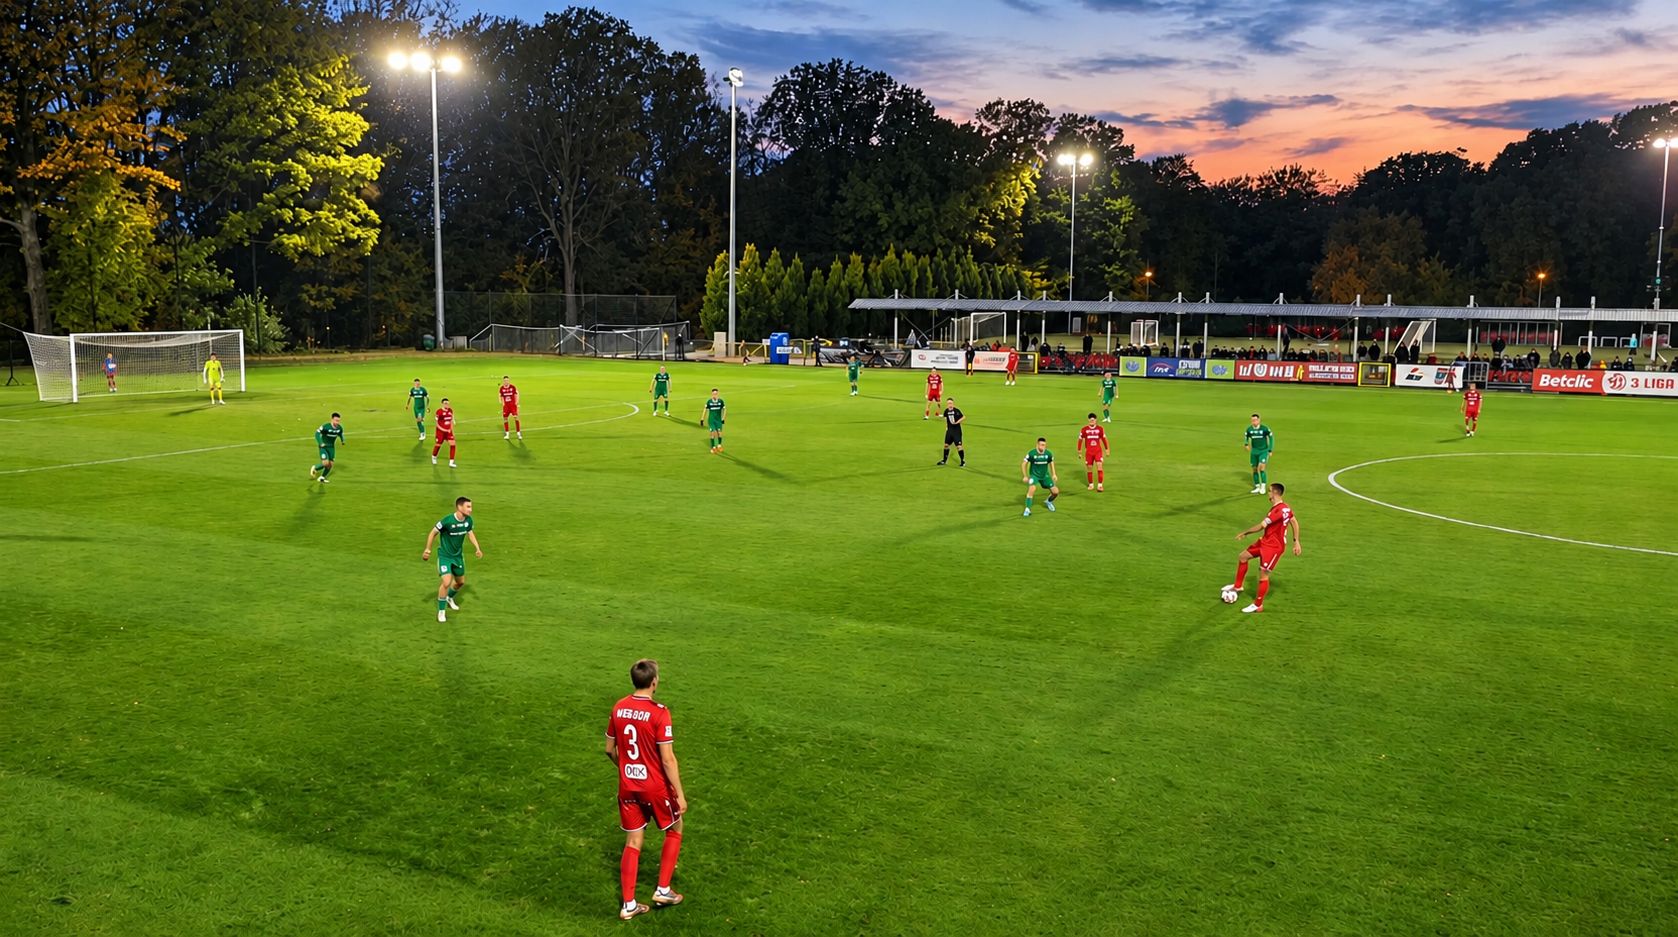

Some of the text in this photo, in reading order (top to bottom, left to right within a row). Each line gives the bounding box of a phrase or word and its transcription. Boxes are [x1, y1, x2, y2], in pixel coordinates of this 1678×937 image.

[1539, 373, 1594, 389] Betclic
[1630, 377, 1674, 390] 3 LIGA
[624, 724, 639, 760] 3
